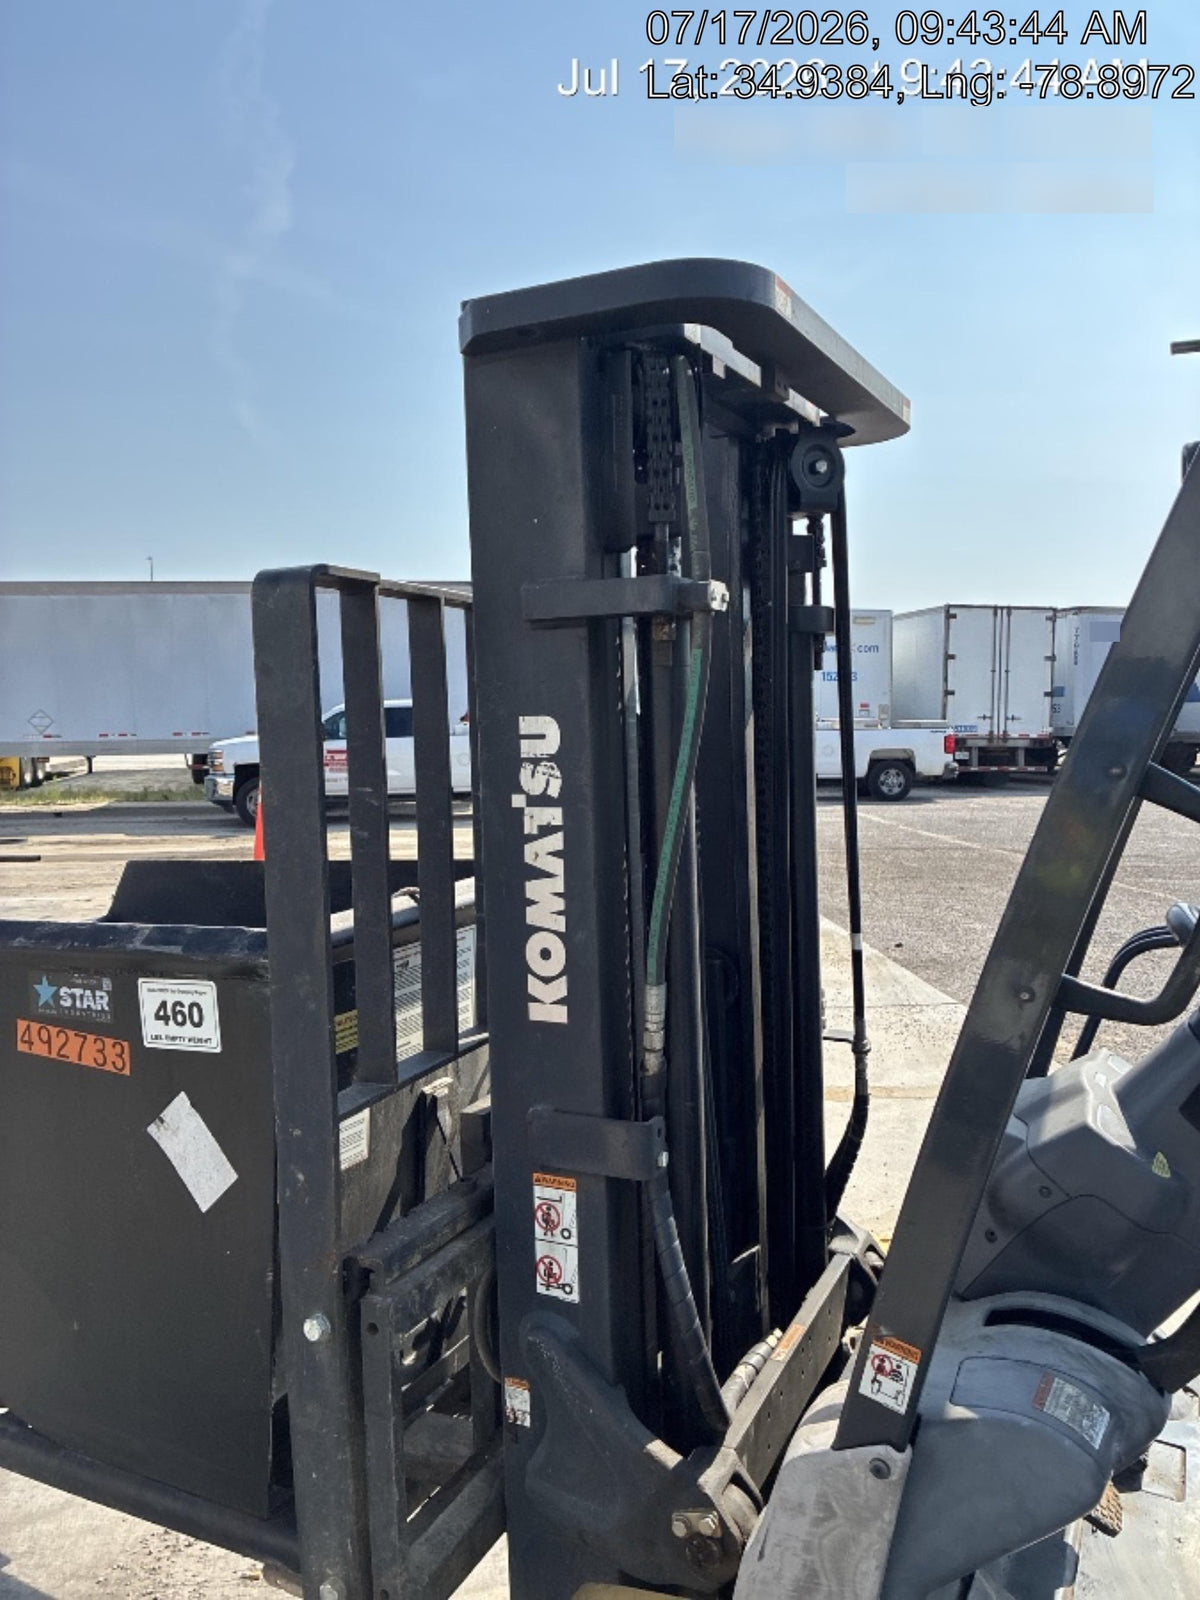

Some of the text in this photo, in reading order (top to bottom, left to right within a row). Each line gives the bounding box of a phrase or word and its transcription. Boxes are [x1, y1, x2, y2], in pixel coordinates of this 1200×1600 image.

[511, 715, 568, 1025] KOMATSU
[59, 986, 110, 1012] STAR
[154, 1000, 204, 1029] 460
[19, 1022, 127, 1074] 492733
